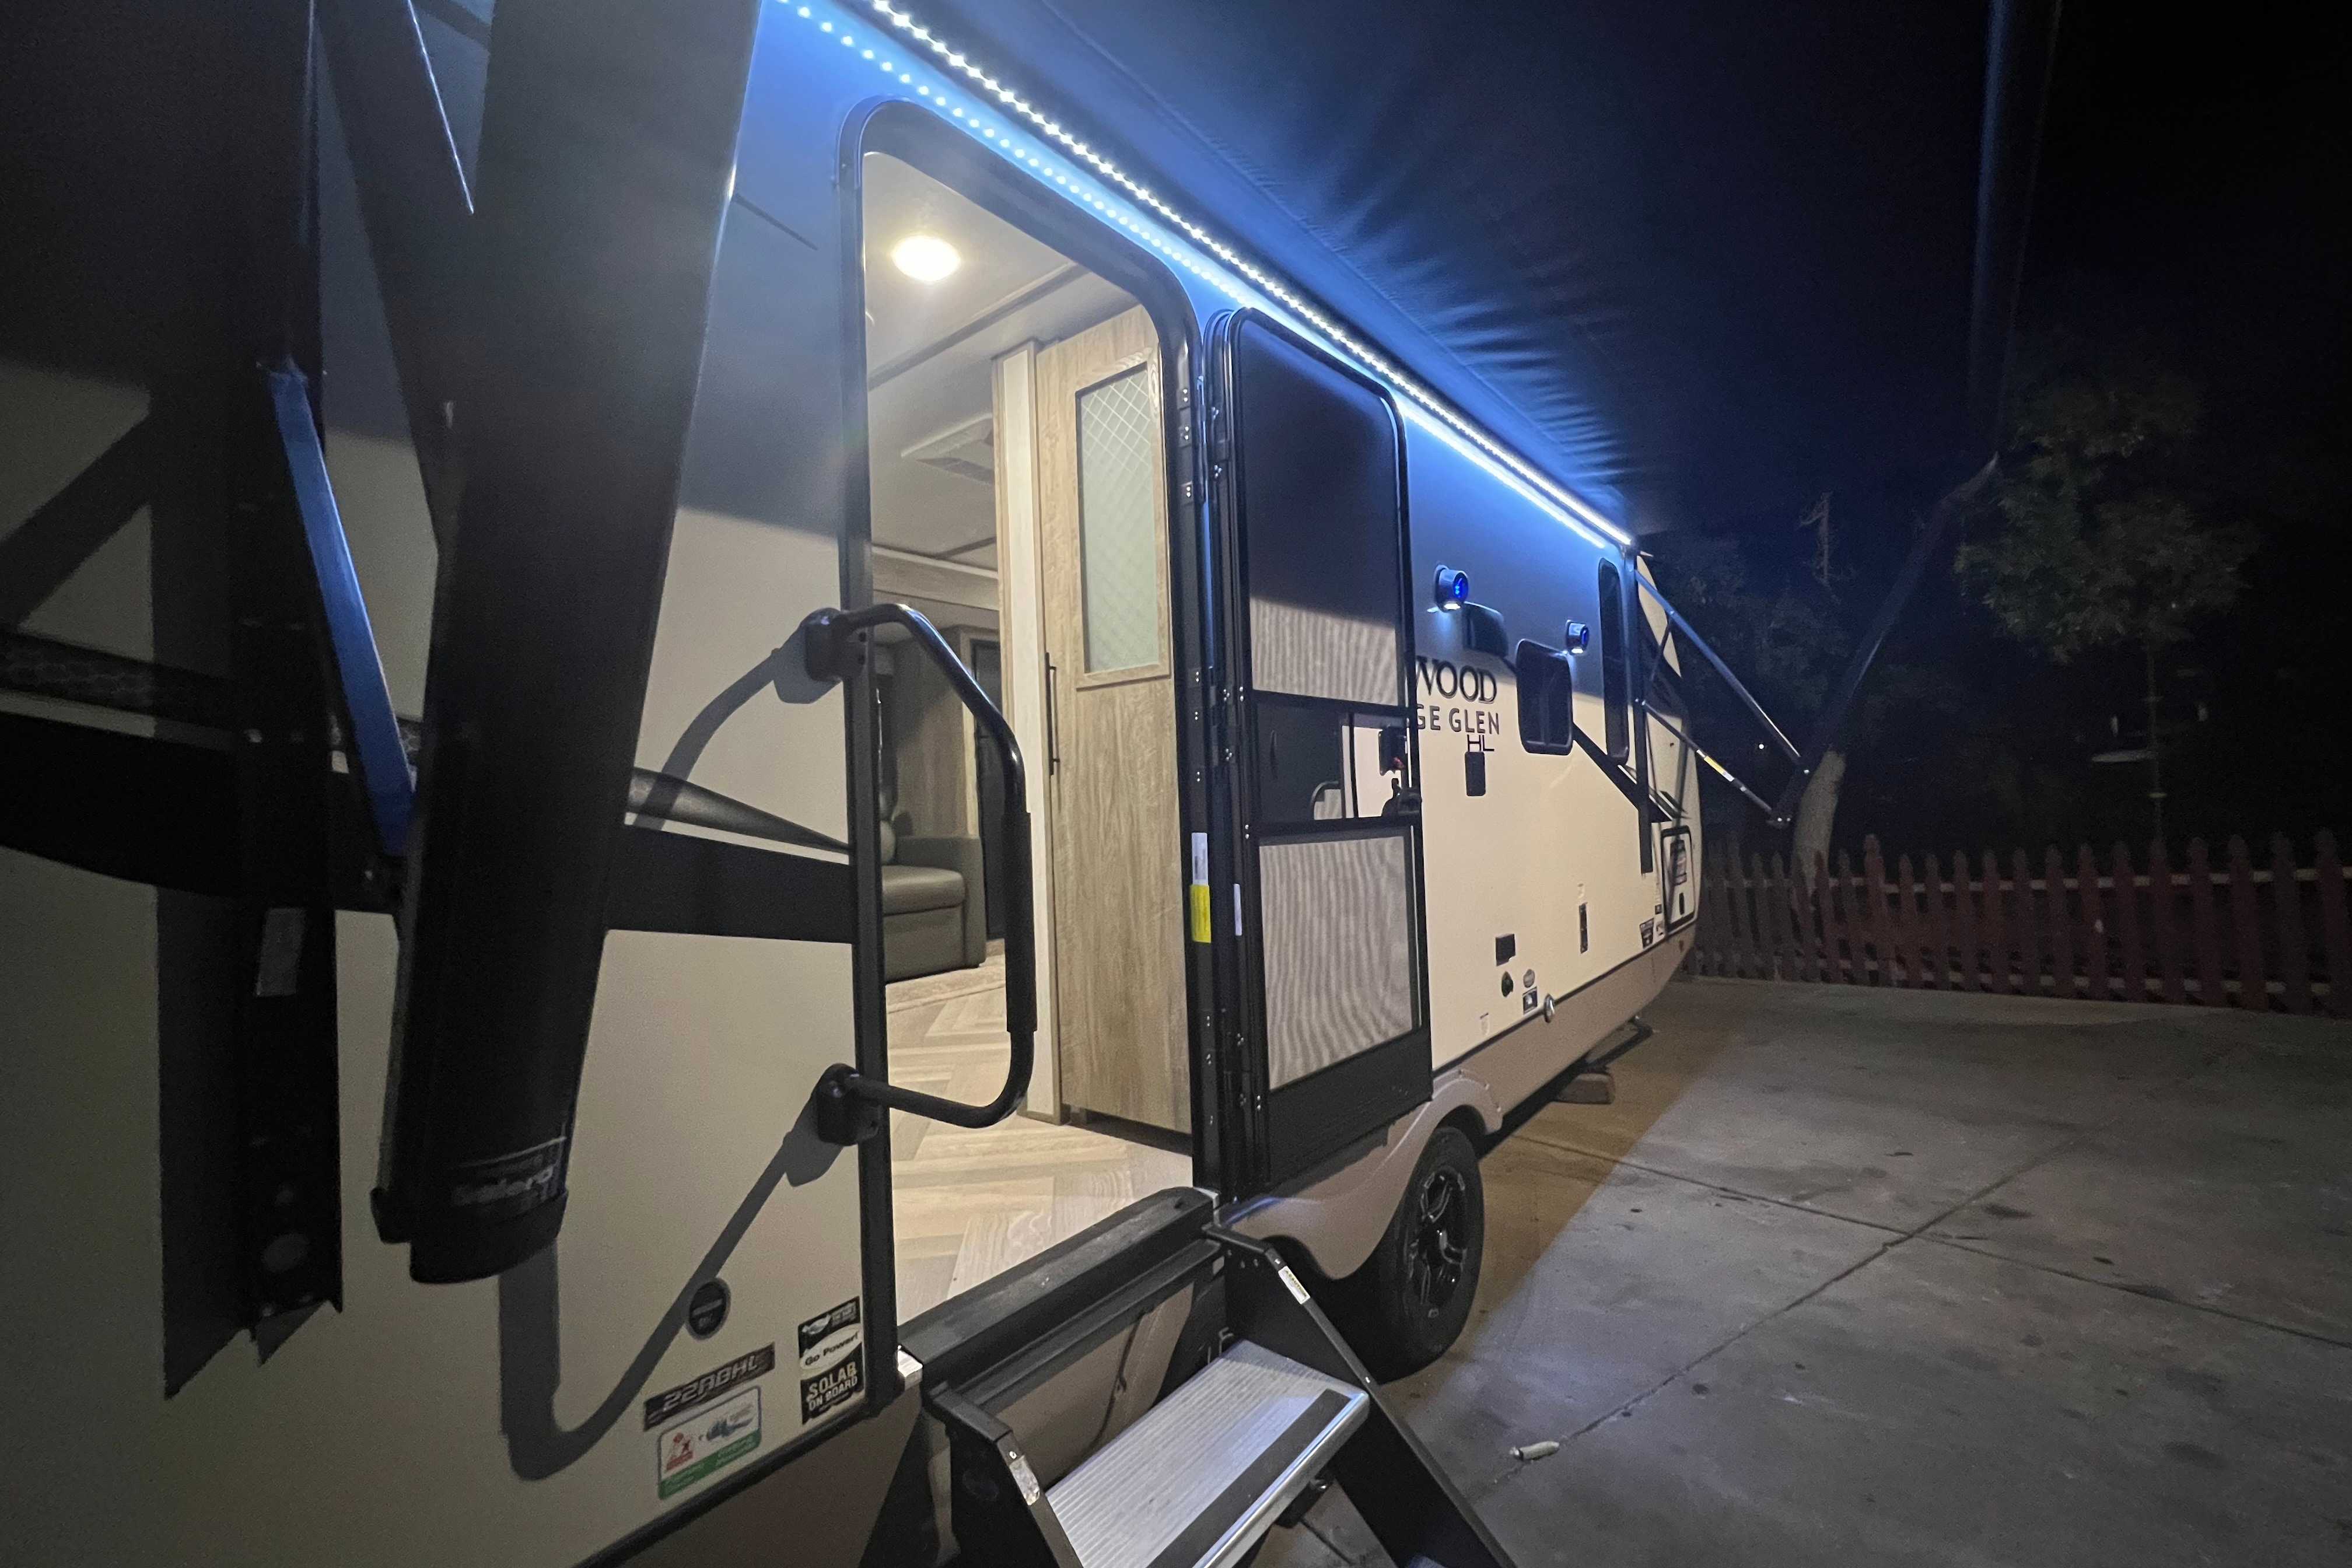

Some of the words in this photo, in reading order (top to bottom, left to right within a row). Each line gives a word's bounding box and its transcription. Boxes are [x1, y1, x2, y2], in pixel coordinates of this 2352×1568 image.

[1448, 708, 1499, 735] GLEN
[1466, 734, 1494, 752] HL
[805, 1354, 820, 1366] Go
[806, 1362, 858, 1402] SOLAR
[808, 1395, 823, 1411] ON
[825, 1376, 858, 1401] BOARD
